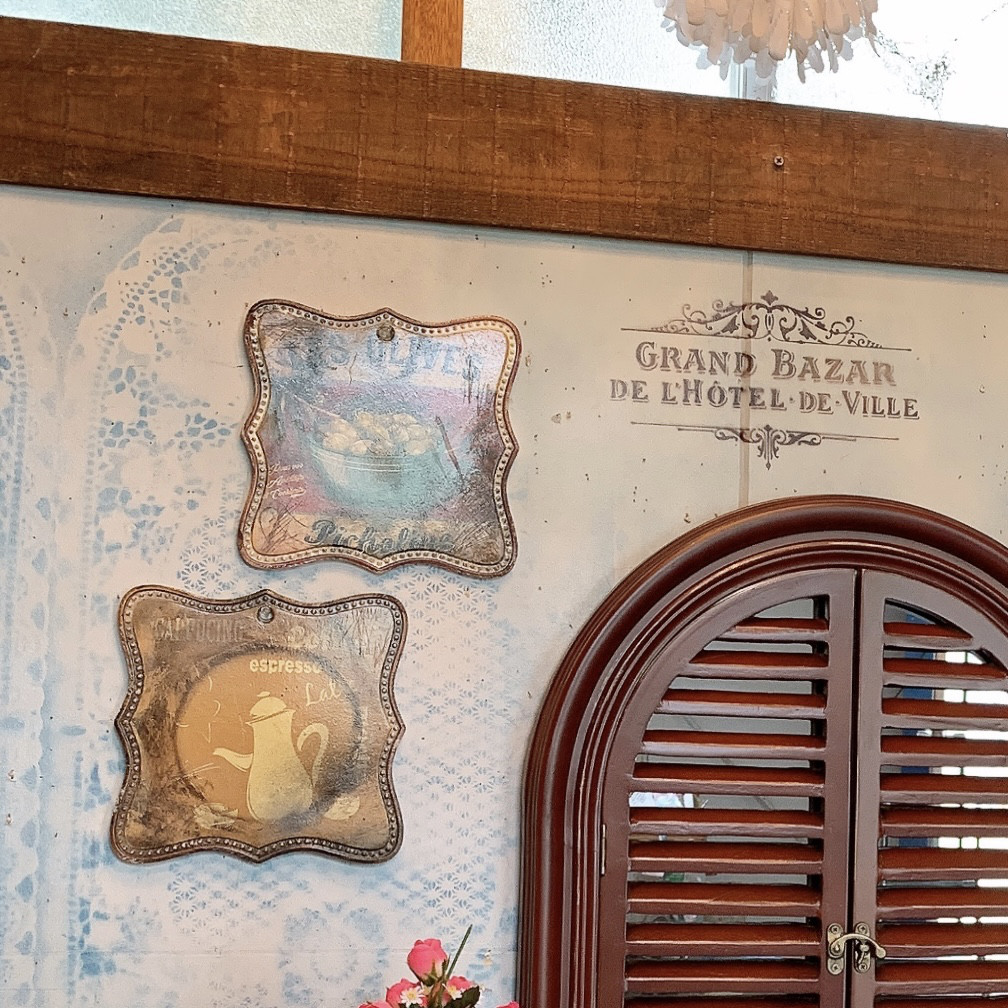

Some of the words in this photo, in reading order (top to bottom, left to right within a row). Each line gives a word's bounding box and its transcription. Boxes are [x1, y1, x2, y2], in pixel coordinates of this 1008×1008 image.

[635, 341, 757, 377] GRAND
[771, 348, 897, 387] BAZAR
[610, 378, 648, 402] DE
